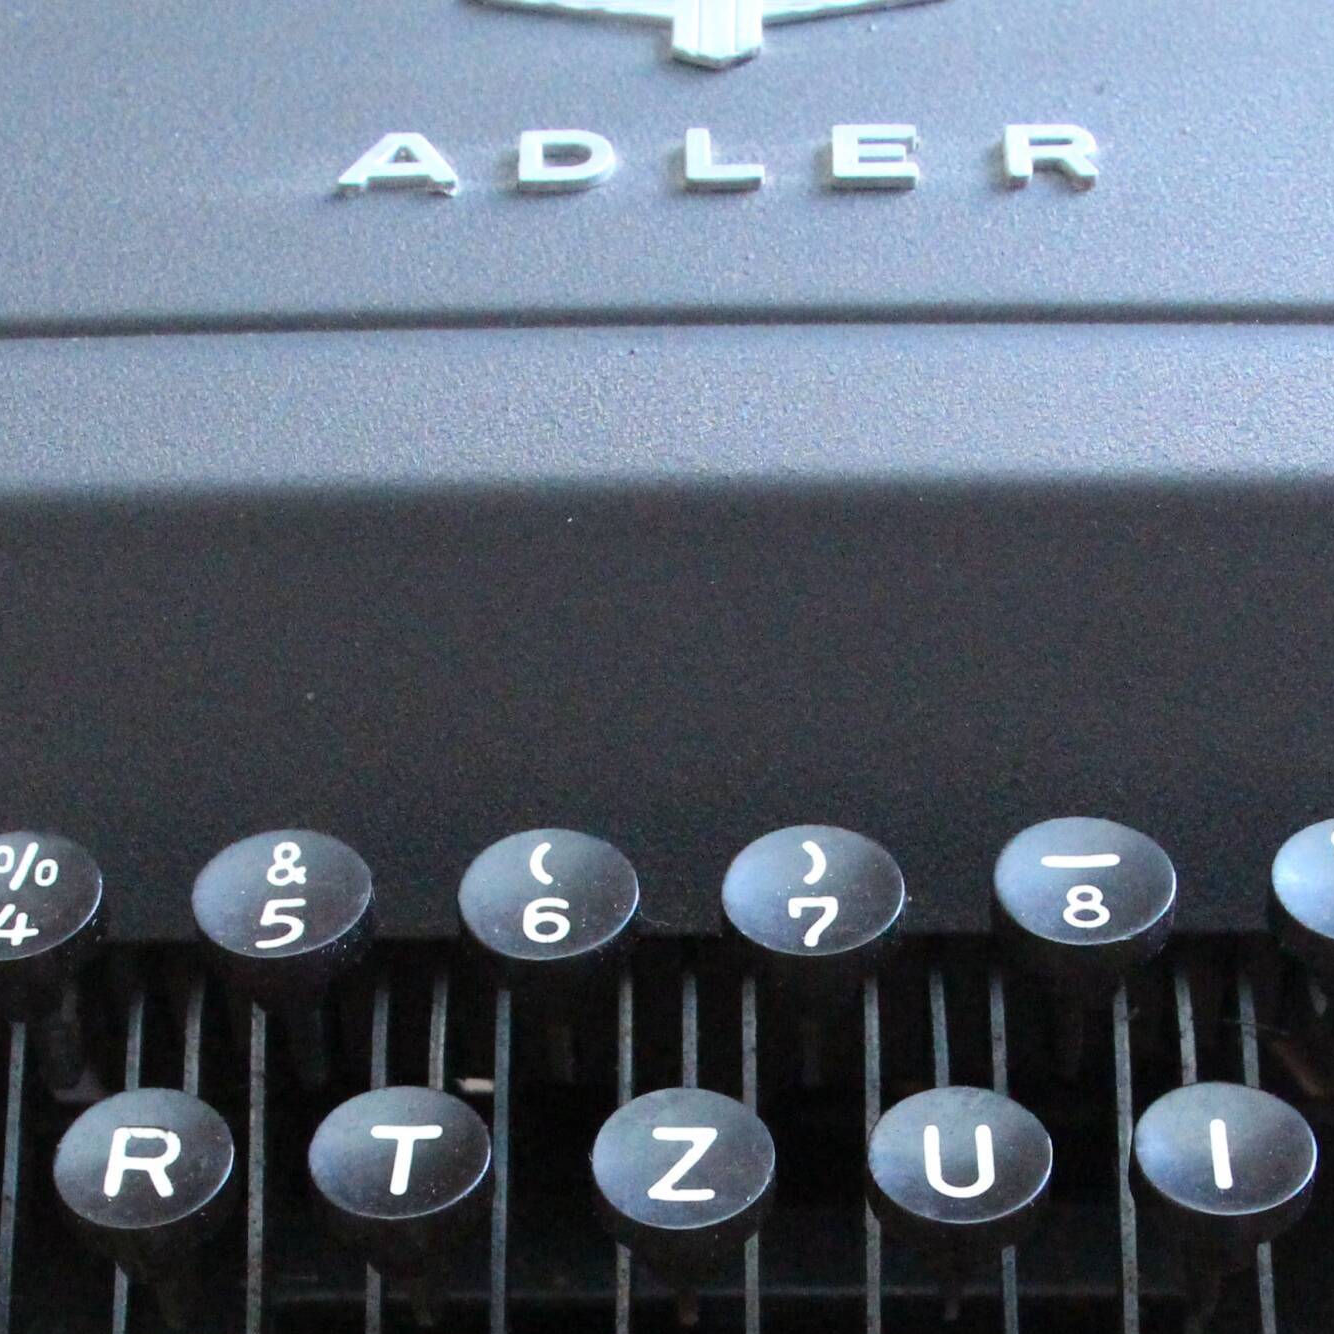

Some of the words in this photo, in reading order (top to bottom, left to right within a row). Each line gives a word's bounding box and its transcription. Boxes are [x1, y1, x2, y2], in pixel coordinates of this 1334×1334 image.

[337, 120, 1101, 196] ADLER
[266, 841, 307, 888] &
[529, 841, 554, 886] (
[802, 839, 827, 886] )
[254, 897, 307, 950] 5
[522, 897, 571, 945] 6
[787, 895, 839, 949] 7
[1062, 884, 1111, 930] 8
[103, 1126, 182, 1199] R
[370, 1123, 444, 1197] T
[647, 1125, 720, 1203] Z
[923, 1123, 996, 1200] U
[1210, 1117, 1234, 1192] I
